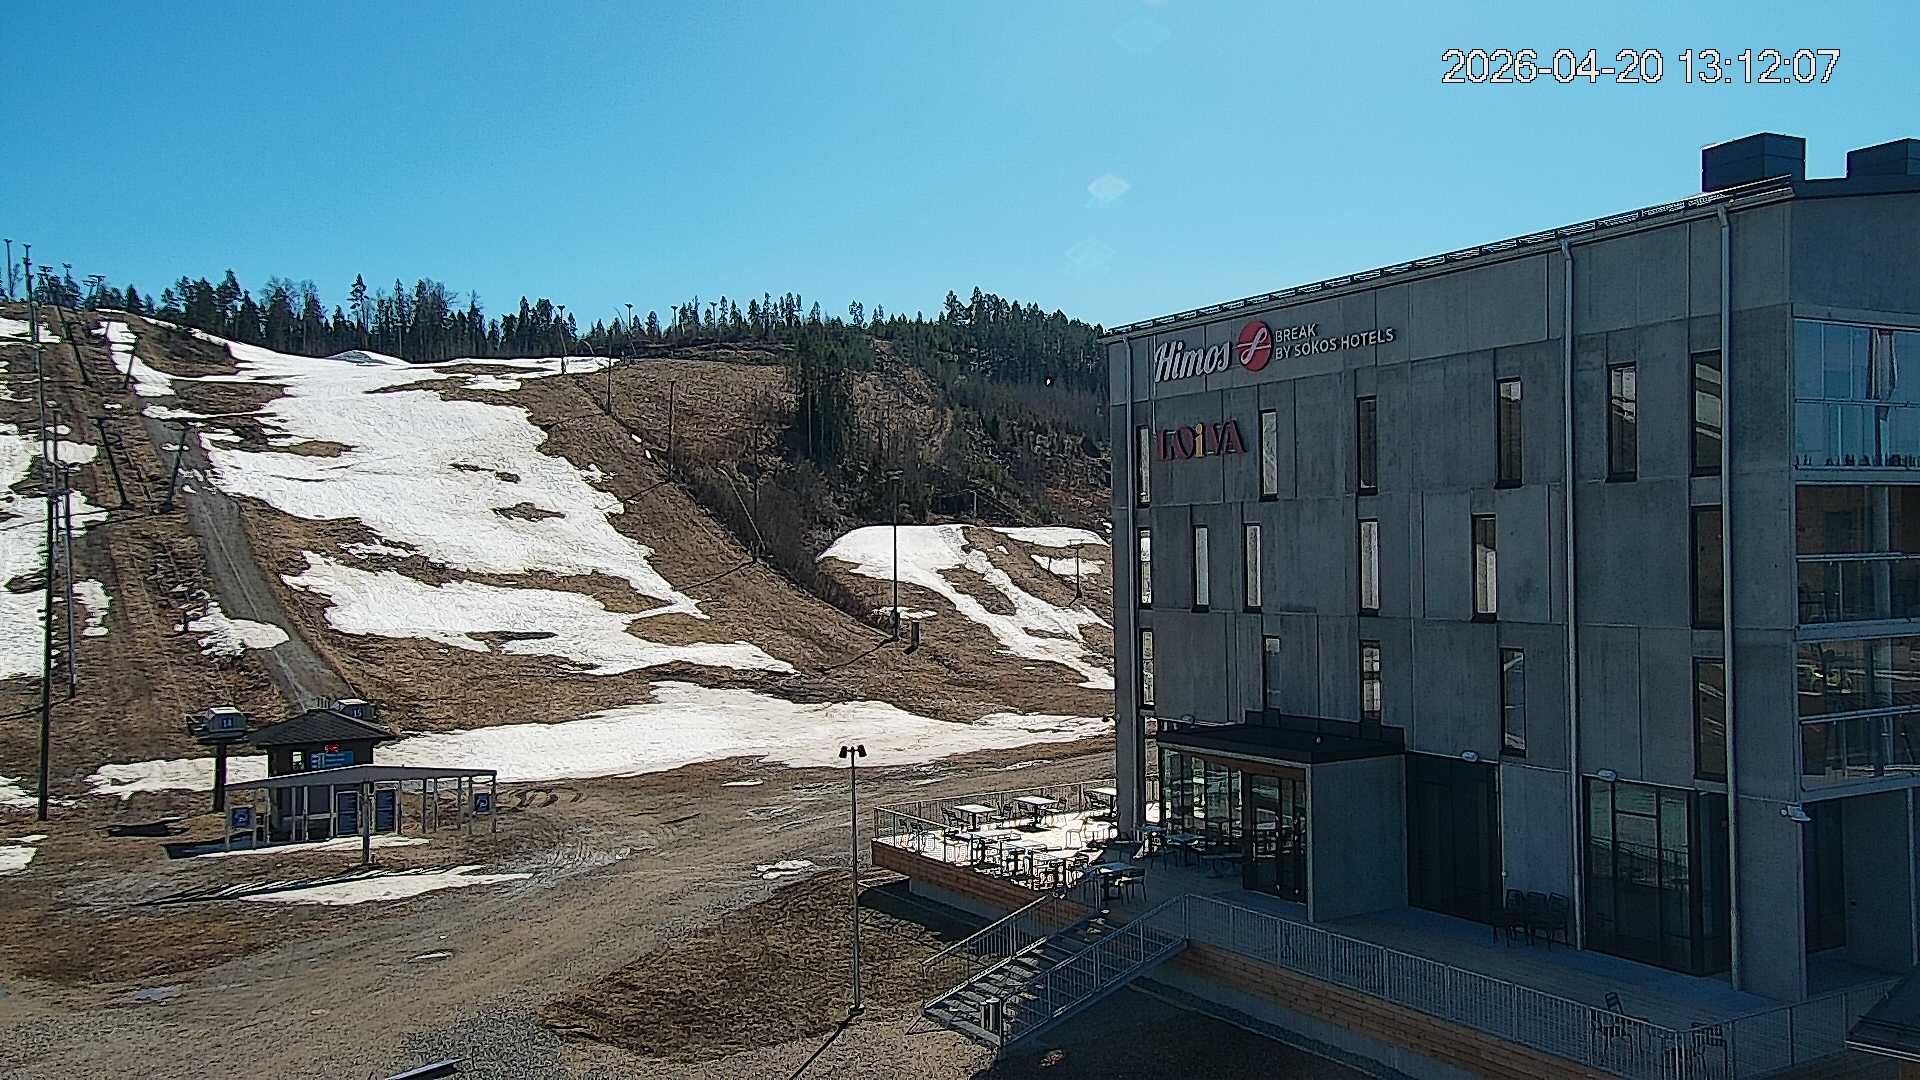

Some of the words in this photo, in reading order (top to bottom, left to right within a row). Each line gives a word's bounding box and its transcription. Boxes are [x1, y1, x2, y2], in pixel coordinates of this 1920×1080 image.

[1275, 323, 1318, 343] BREAK
[1275, 345, 1291, 360] BY
[1294, 337, 1338, 357] SOKOS
[1341, 328, 1395, 350] HOTELS
[1153, 341, 1231, 382] Himos
